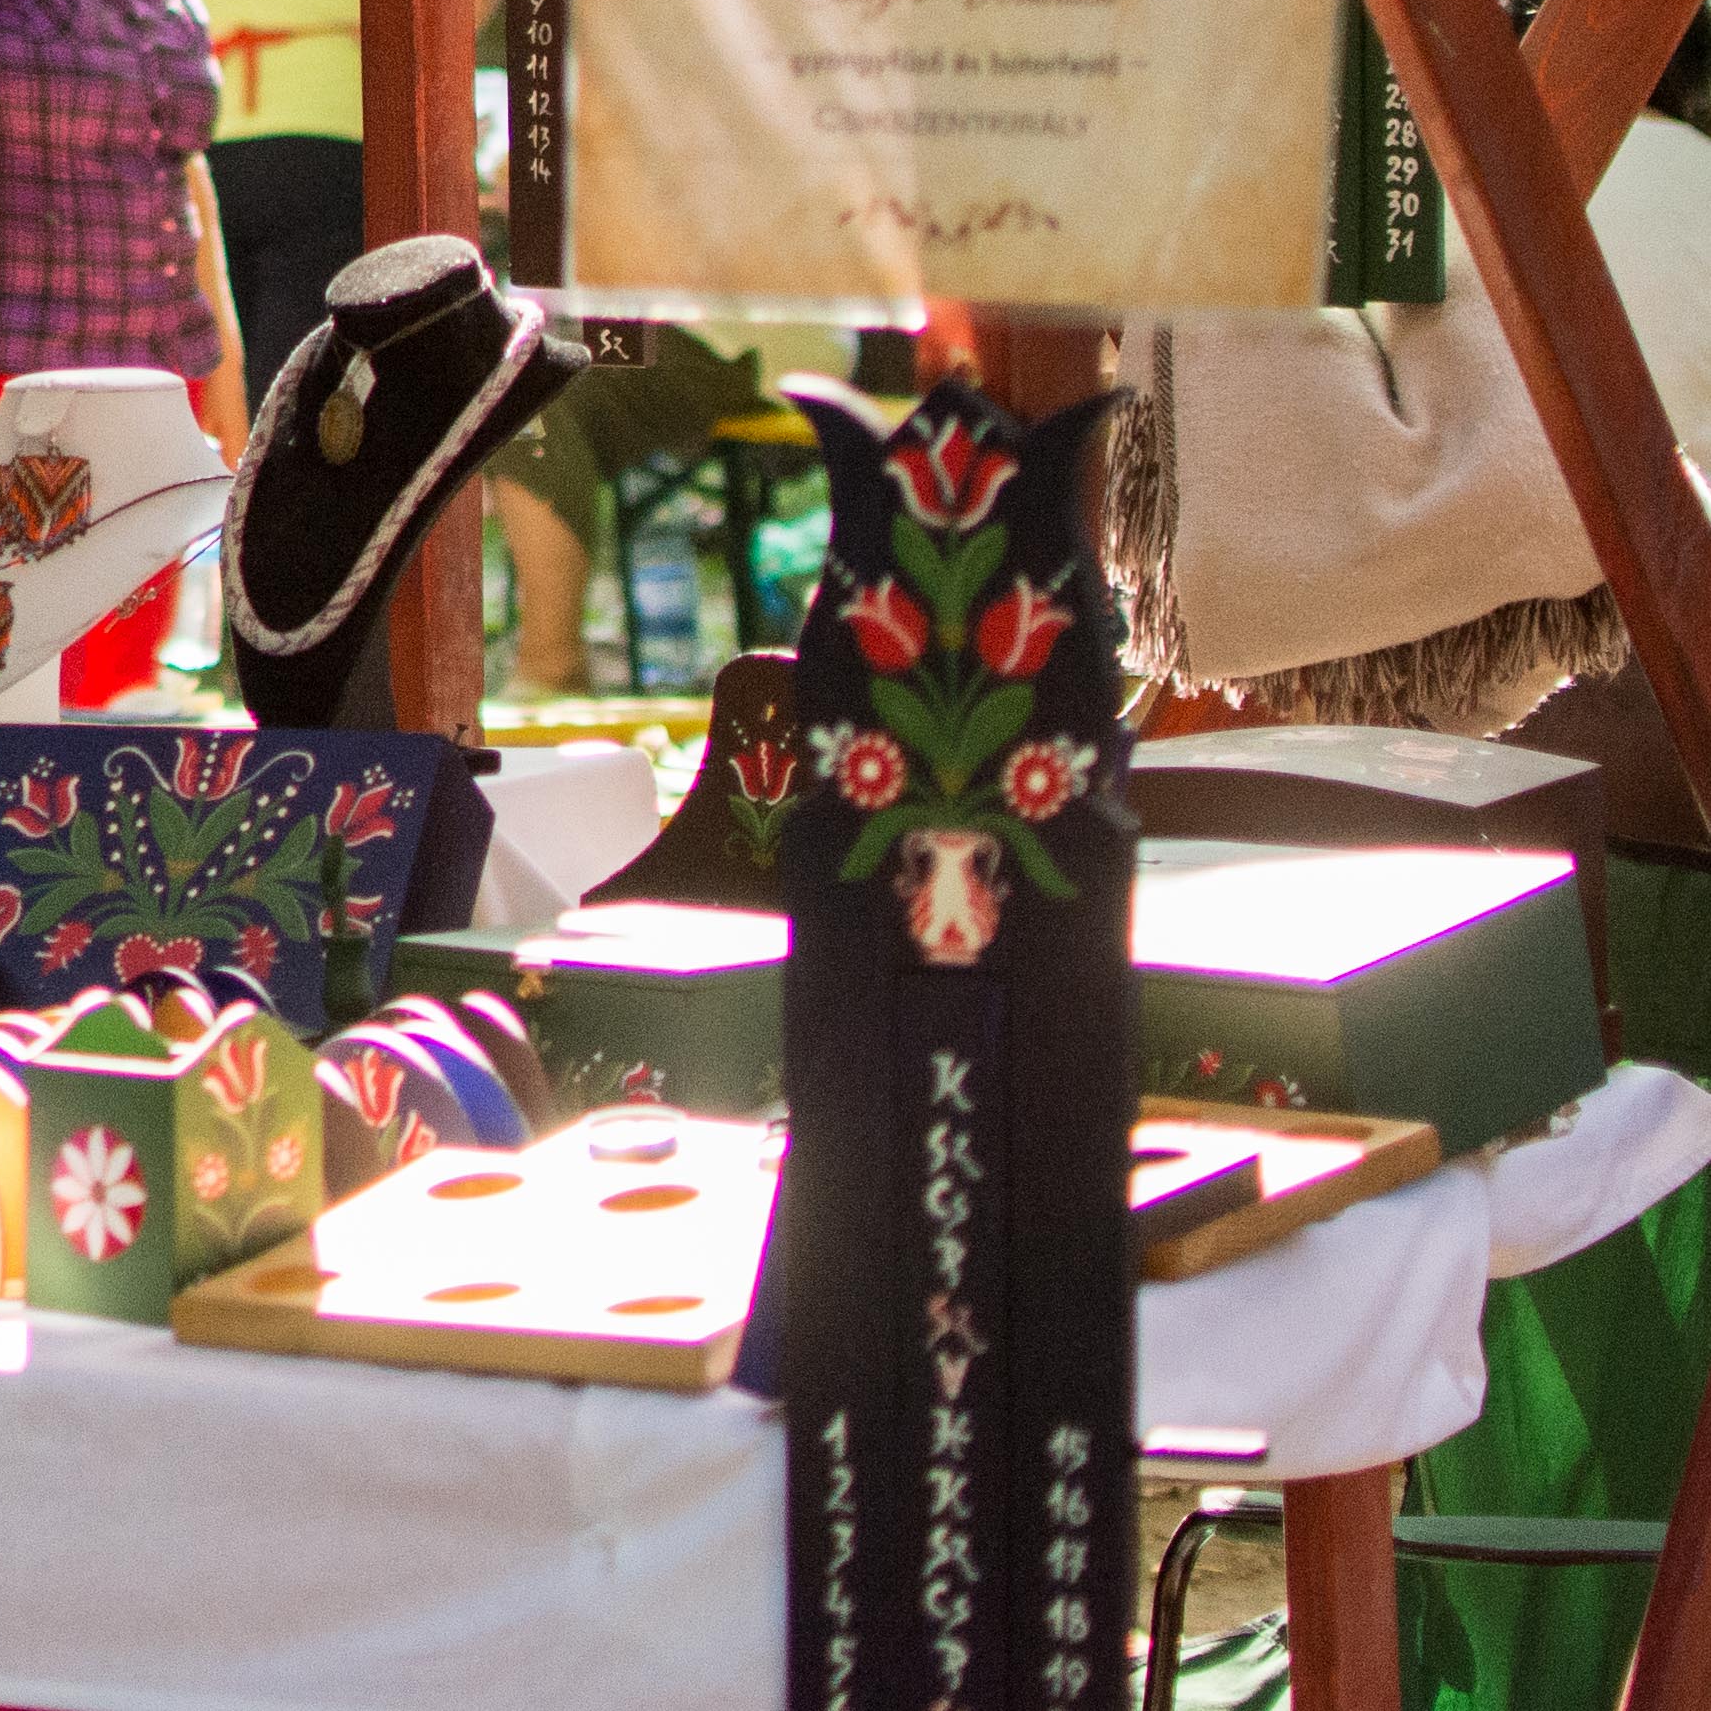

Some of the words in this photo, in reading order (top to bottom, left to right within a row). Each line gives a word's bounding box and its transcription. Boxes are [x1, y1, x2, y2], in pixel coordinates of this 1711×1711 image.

[527, 19, 553, 46] 10
[526, 53, 548, 80] 11
[528, 89, 553, 116] 12
[528, 124, 551, 154] 13
[1385, 117, 1418, 149] 28
[529, 157, 552, 184] 14
[1385, 155, 1419, 186] 29
[1386, 189, 1419, 225] 30
[1386, 228, 1414, 264] 31
[931, 1049, 974, 1110] K
[821, 1410, 847, 1461] 1
[826, 1466, 857, 1514] 2
[1046, 1481, 1090, 1525] 16
[827, 1522, 855, 1575] 3
[826, 1580, 856, 1628] 4
[1045, 1596, 1089, 1643] 18
[829, 1637, 858, 1691] 5
[1044, 1652, 1089, 1700] 19
